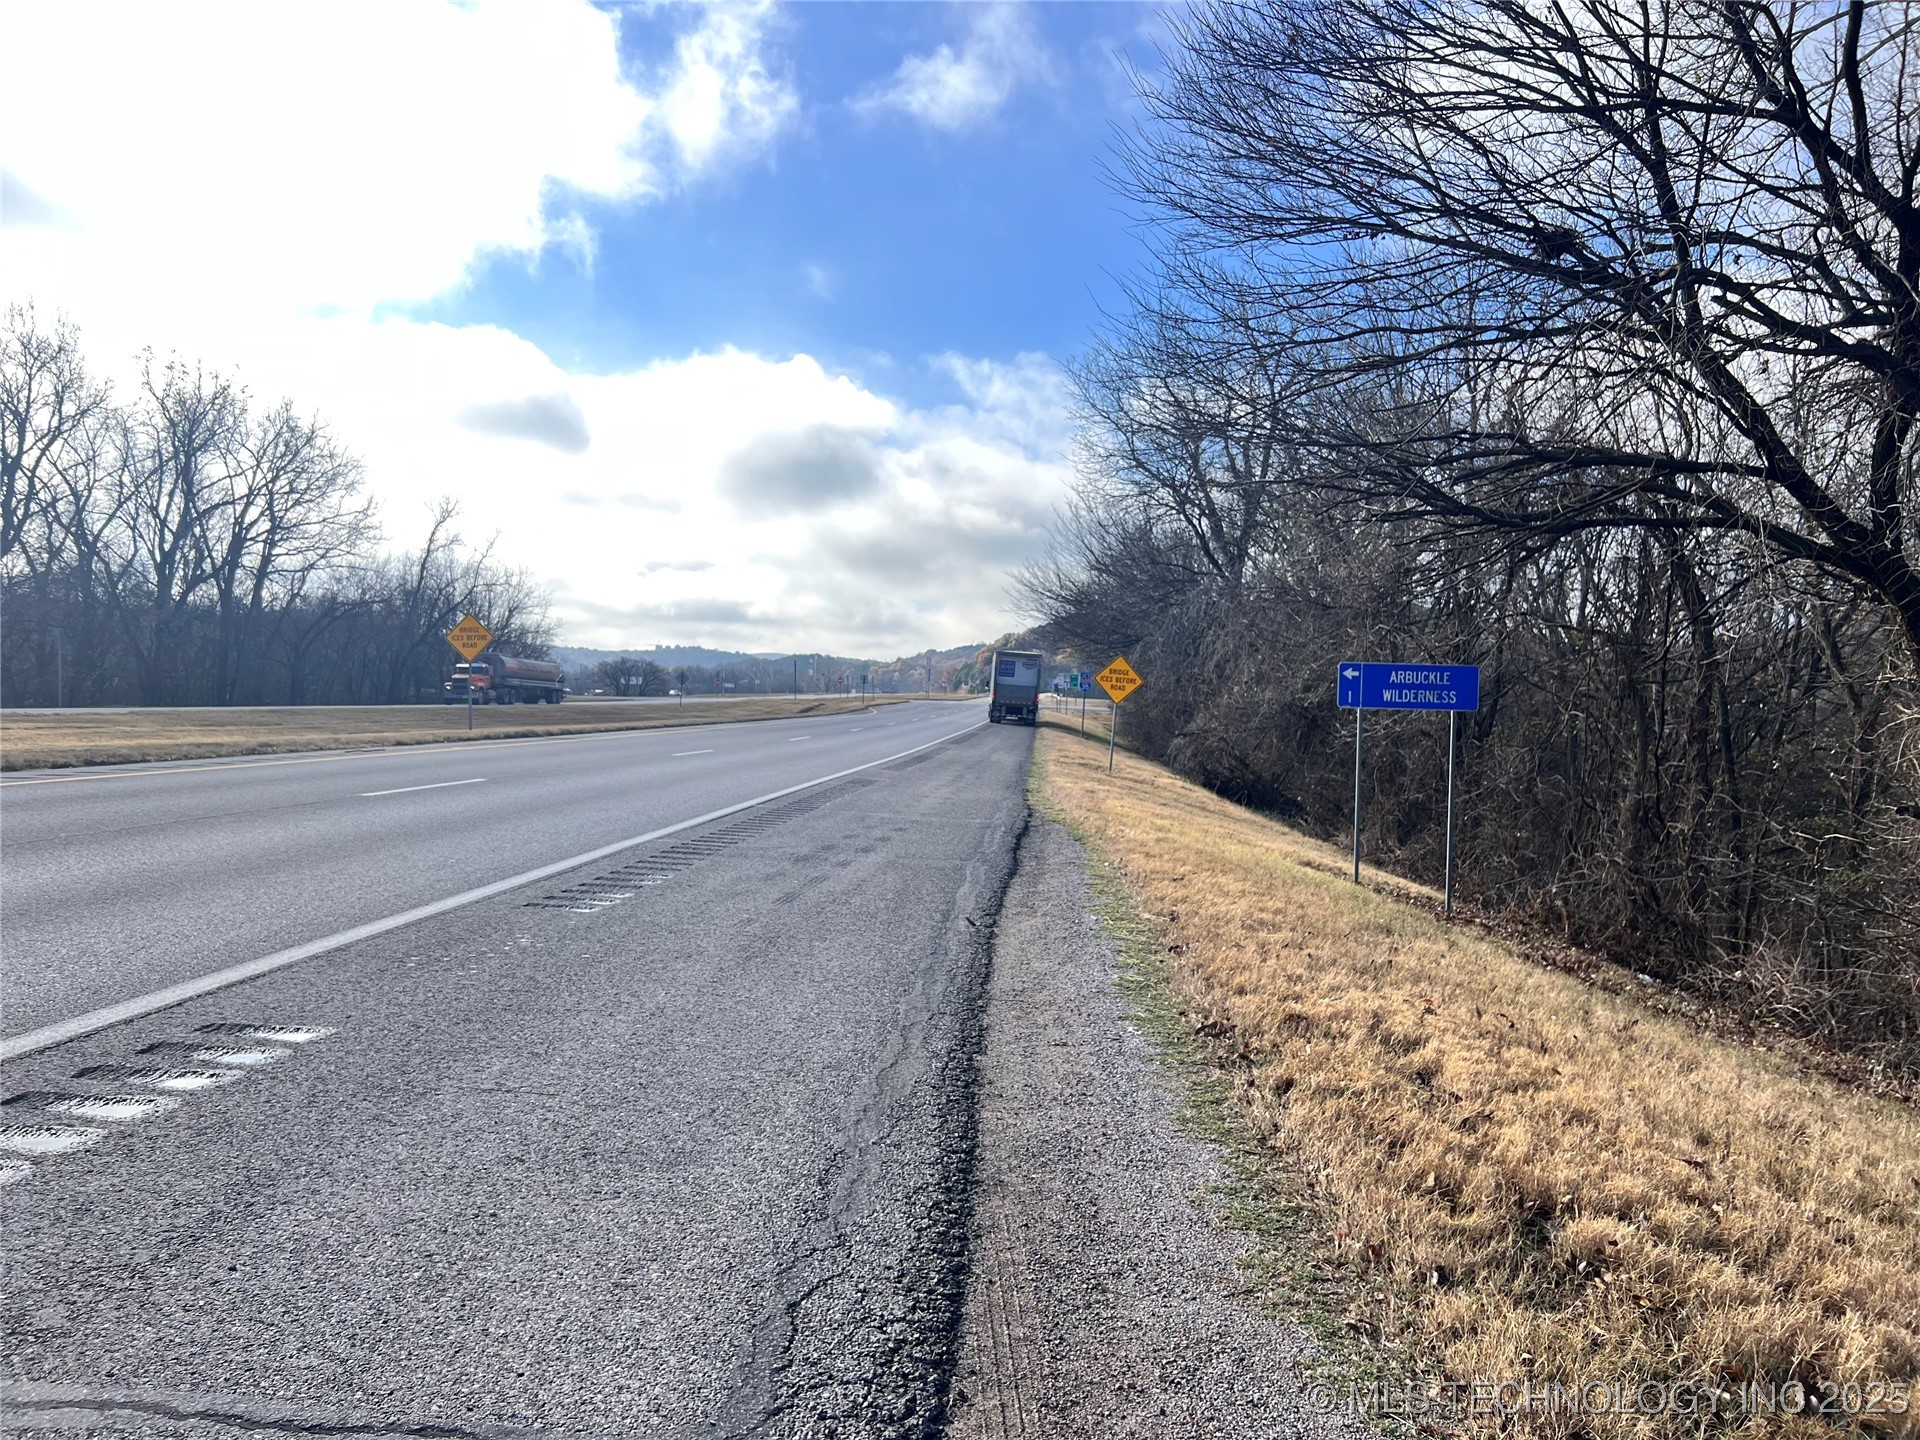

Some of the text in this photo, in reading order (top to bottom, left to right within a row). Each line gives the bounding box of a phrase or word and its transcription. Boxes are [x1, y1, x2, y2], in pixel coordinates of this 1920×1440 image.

[1109, 668, 1130, 676] BRIDGE
[1389, 670, 1451, 685] ARBUCKLE
[1099, 675, 1137, 685] ICES BEFORE
[1111, 683, 1126, 691] ROAD
[1348, 690, 1352, 703] 1
[1382, 689, 1457, 704] WILDERNESS
